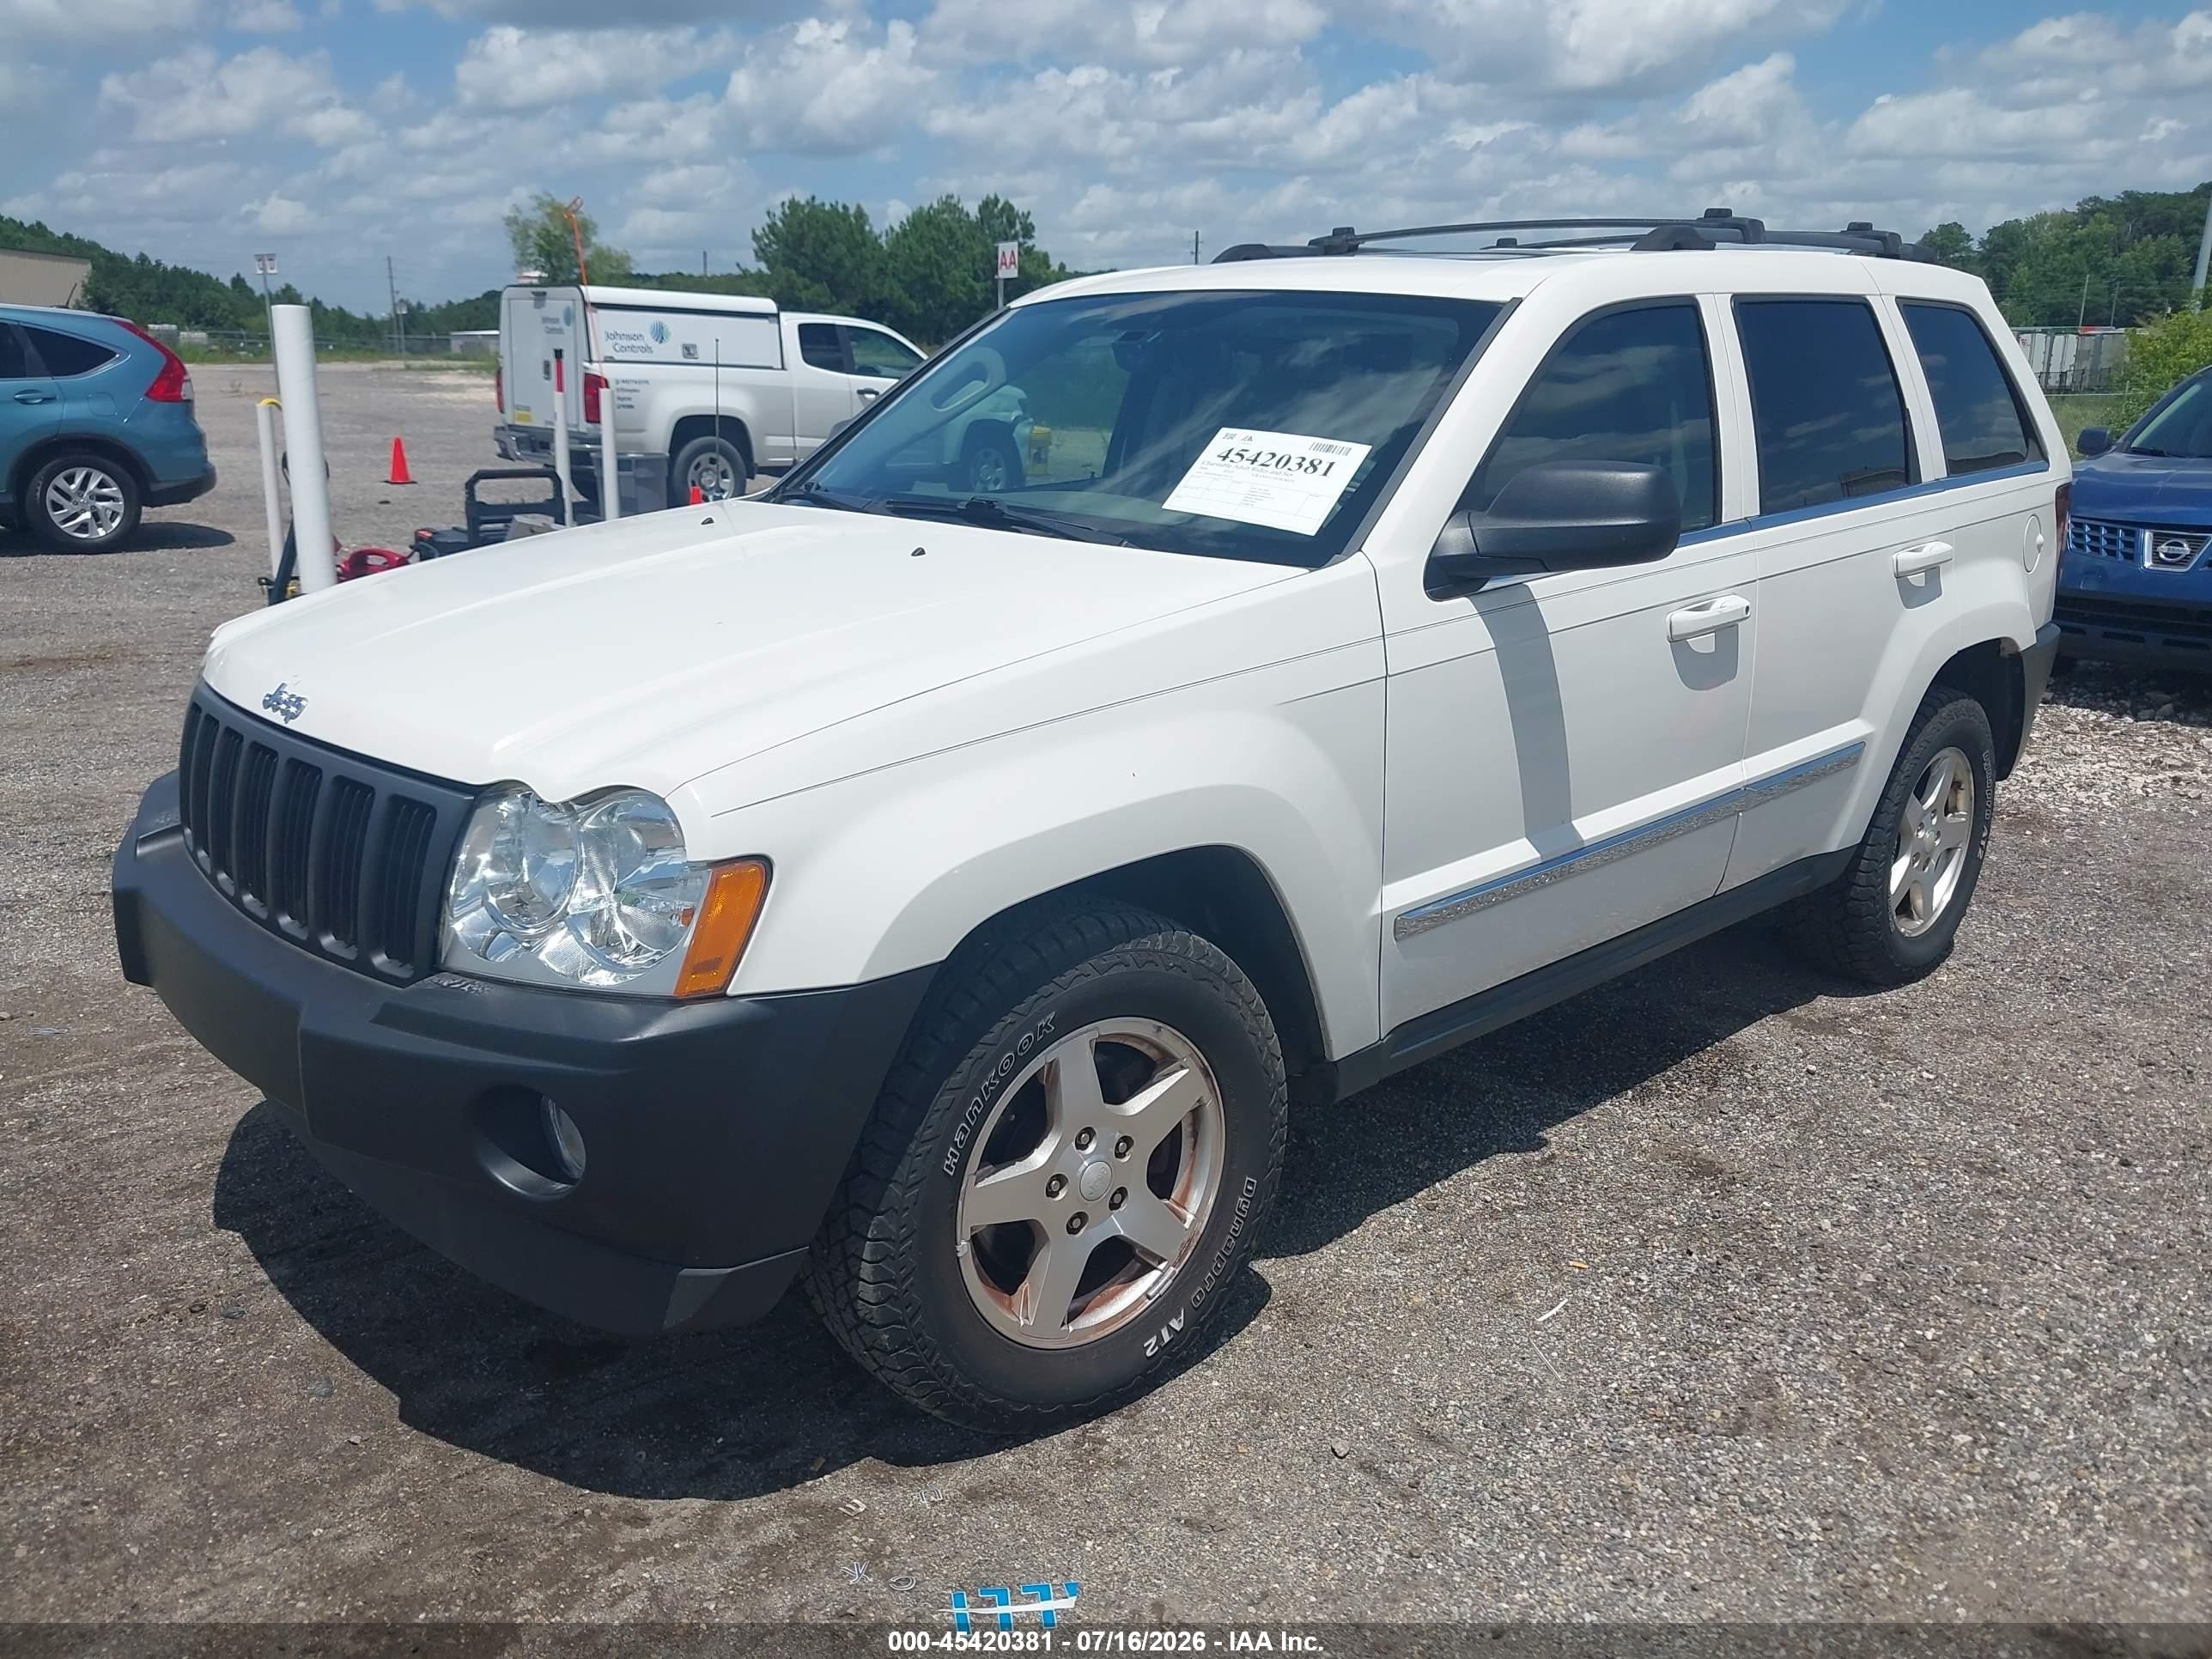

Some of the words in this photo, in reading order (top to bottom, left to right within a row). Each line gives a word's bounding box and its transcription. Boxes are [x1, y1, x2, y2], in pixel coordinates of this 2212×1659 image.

[1000, 249, 1018, 270] AA
[605, 330, 646, 342] Johnson
[612, 343, 654, 354] Controls
[1216, 447, 1335, 477] 45420381
[1143, 1307, 1185, 1358] AT2
